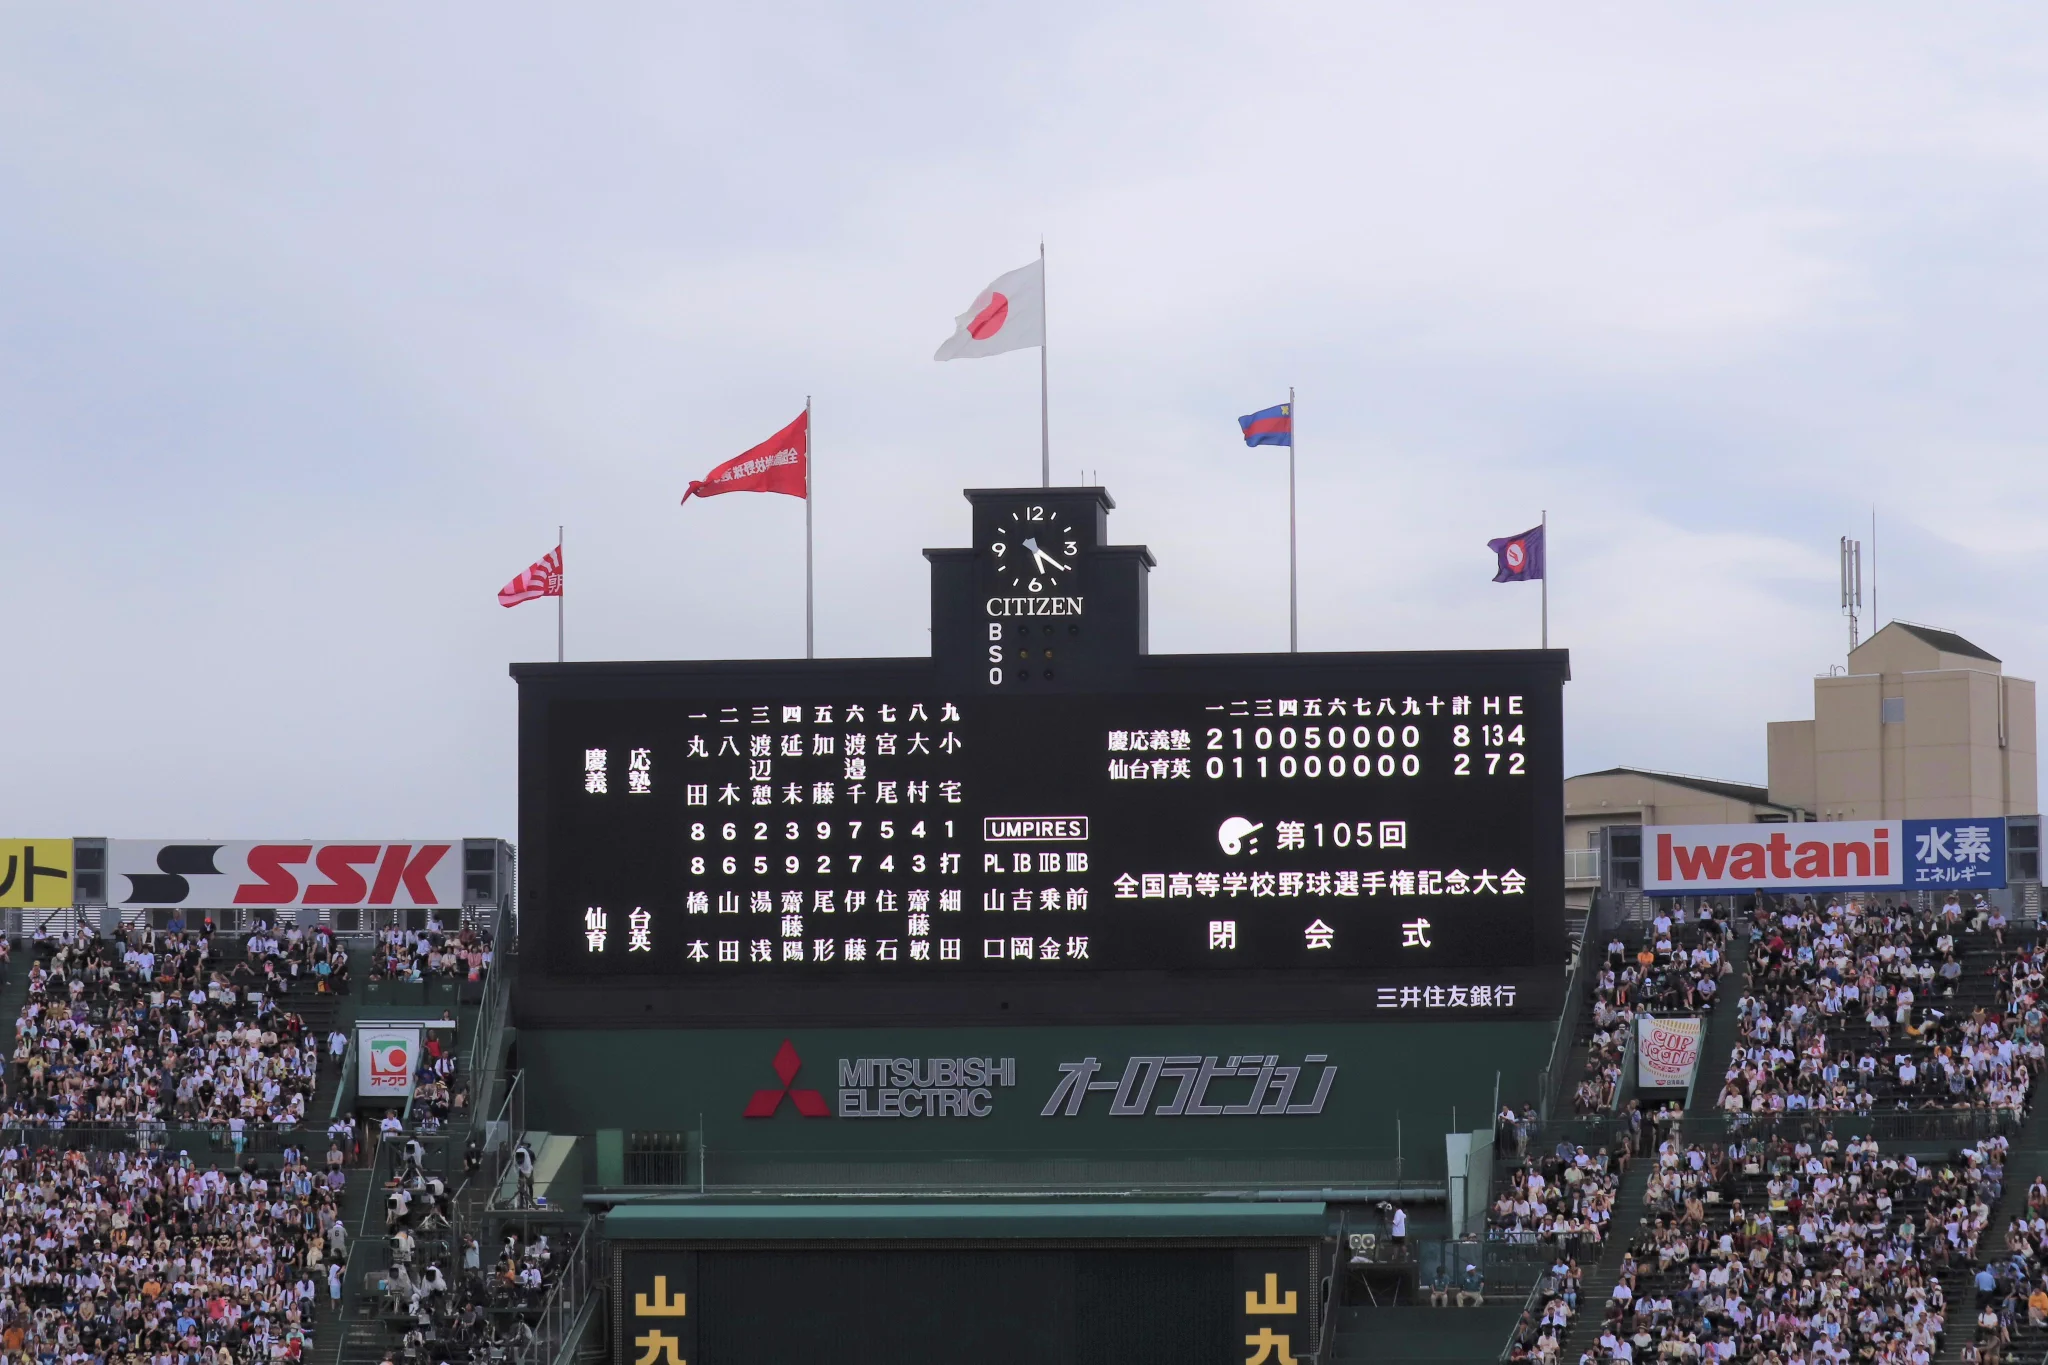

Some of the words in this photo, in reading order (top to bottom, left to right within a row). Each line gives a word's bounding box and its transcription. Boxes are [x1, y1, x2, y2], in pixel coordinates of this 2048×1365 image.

[1027, 506, 1044, 521] 12
[992, 543, 1006, 557] 9
[1064, 541, 1078, 556] 3
[1028, 578, 1042, 592] 6
[986, 597, 1083, 616] CITIZEN
[989, 623, 1002, 641] B
[989, 645, 1003, 663] S
[720, 708, 739, 722] 二
[751, 706, 770, 723] 三
[783, 706, 801, 723] 四
[814, 705, 833, 723] 五
[846, 705, 864, 722] 六
[878, 704, 896, 722] 七
[909, 703, 928, 721] 八
[941, 703, 960, 722] 九
[1108, 729, 1190, 752] 慶応義塾
[1207, 728, 1222, 749] 2
[1233, 728, 1242, 749] 1
[1255, 728, 1272, 749] 0
[1280, 727, 1296, 749] 0
[1305, 727, 1321, 748] 5
[1329, 727, 1345, 748] 0
[1353, 726, 1370, 748] 0
[1378, 726, 1394, 748] 0
[1402, 726, 1419, 747] 0
[1453, 725, 1470, 747] 8
[1482, 725, 1503, 746] 13
[1508, 725, 1525, 745] 4
[1108, 758, 1190, 780] 仙台育英
[1206, 757, 1223, 778] 0
[1233, 757, 1242, 778] 1
[1257, 757, 1266, 777] 1
[1280, 756, 1297, 778] 0
[1304, 756, 1321, 777] 0
[1329, 755, 1346, 777] 0
[1353, 755, 1370, 777] 0
[1378, 755, 1395, 776] 0
[1402, 754, 1419, 776] 0
[1454, 754, 1470, 775] 2
[1485, 754, 1500, 775] 7
[1509, 753, 1525, 774] 2
[691, 823, 705, 840] 8
[723, 823, 736, 840] 6
[754, 822, 767, 840] 2
[786, 822, 799, 840] 3
[817, 822, 830, 839] 9
[849, 822, 862, 839] 7
[881, 821, 894, 839] 5
[912, 821, 926, 838] 4
[945, 821, 953, 837] 1
[992, 821, 1081, 837] UMPIRES
[1276, 821, 1406, 850] 第105回
[1657, 828, 1889, 881] Iwatani
[1915, 826, 1991, 863] 水素
[691, 857, 705, 874] 8
[723, 857, 736, 874] 6
[754, 857, 767, 874] 5
[786, 856, 799, 874] 9
[817, 856, 830, 873] 2
[849, 856, 862, 873] 7
[880, 855, 894, 872] 4
[912, 855, 925, 872] 3
[940, 853, 960, 874] 打
[985, 854, 1005, 872] PL
[233, 845, 451, 904] SSK
[1114, 869, 1526, 899] 全国高等学校野球選手権記念大会
[1915, 866, 1991, 883] エネルギー
[1377, 985, 1516, 1008] 三井住友銀行
[1651, 1028, 1694, 1050] CUP
[371, 1077, 407, 1086] オークワ
[838, 1057, 1016, 1088] MITSUBISHI
[1040, 1054, 1338, 1116] オーロラビジョン
[838, 1088, 993, 1118] ELECTRIC
